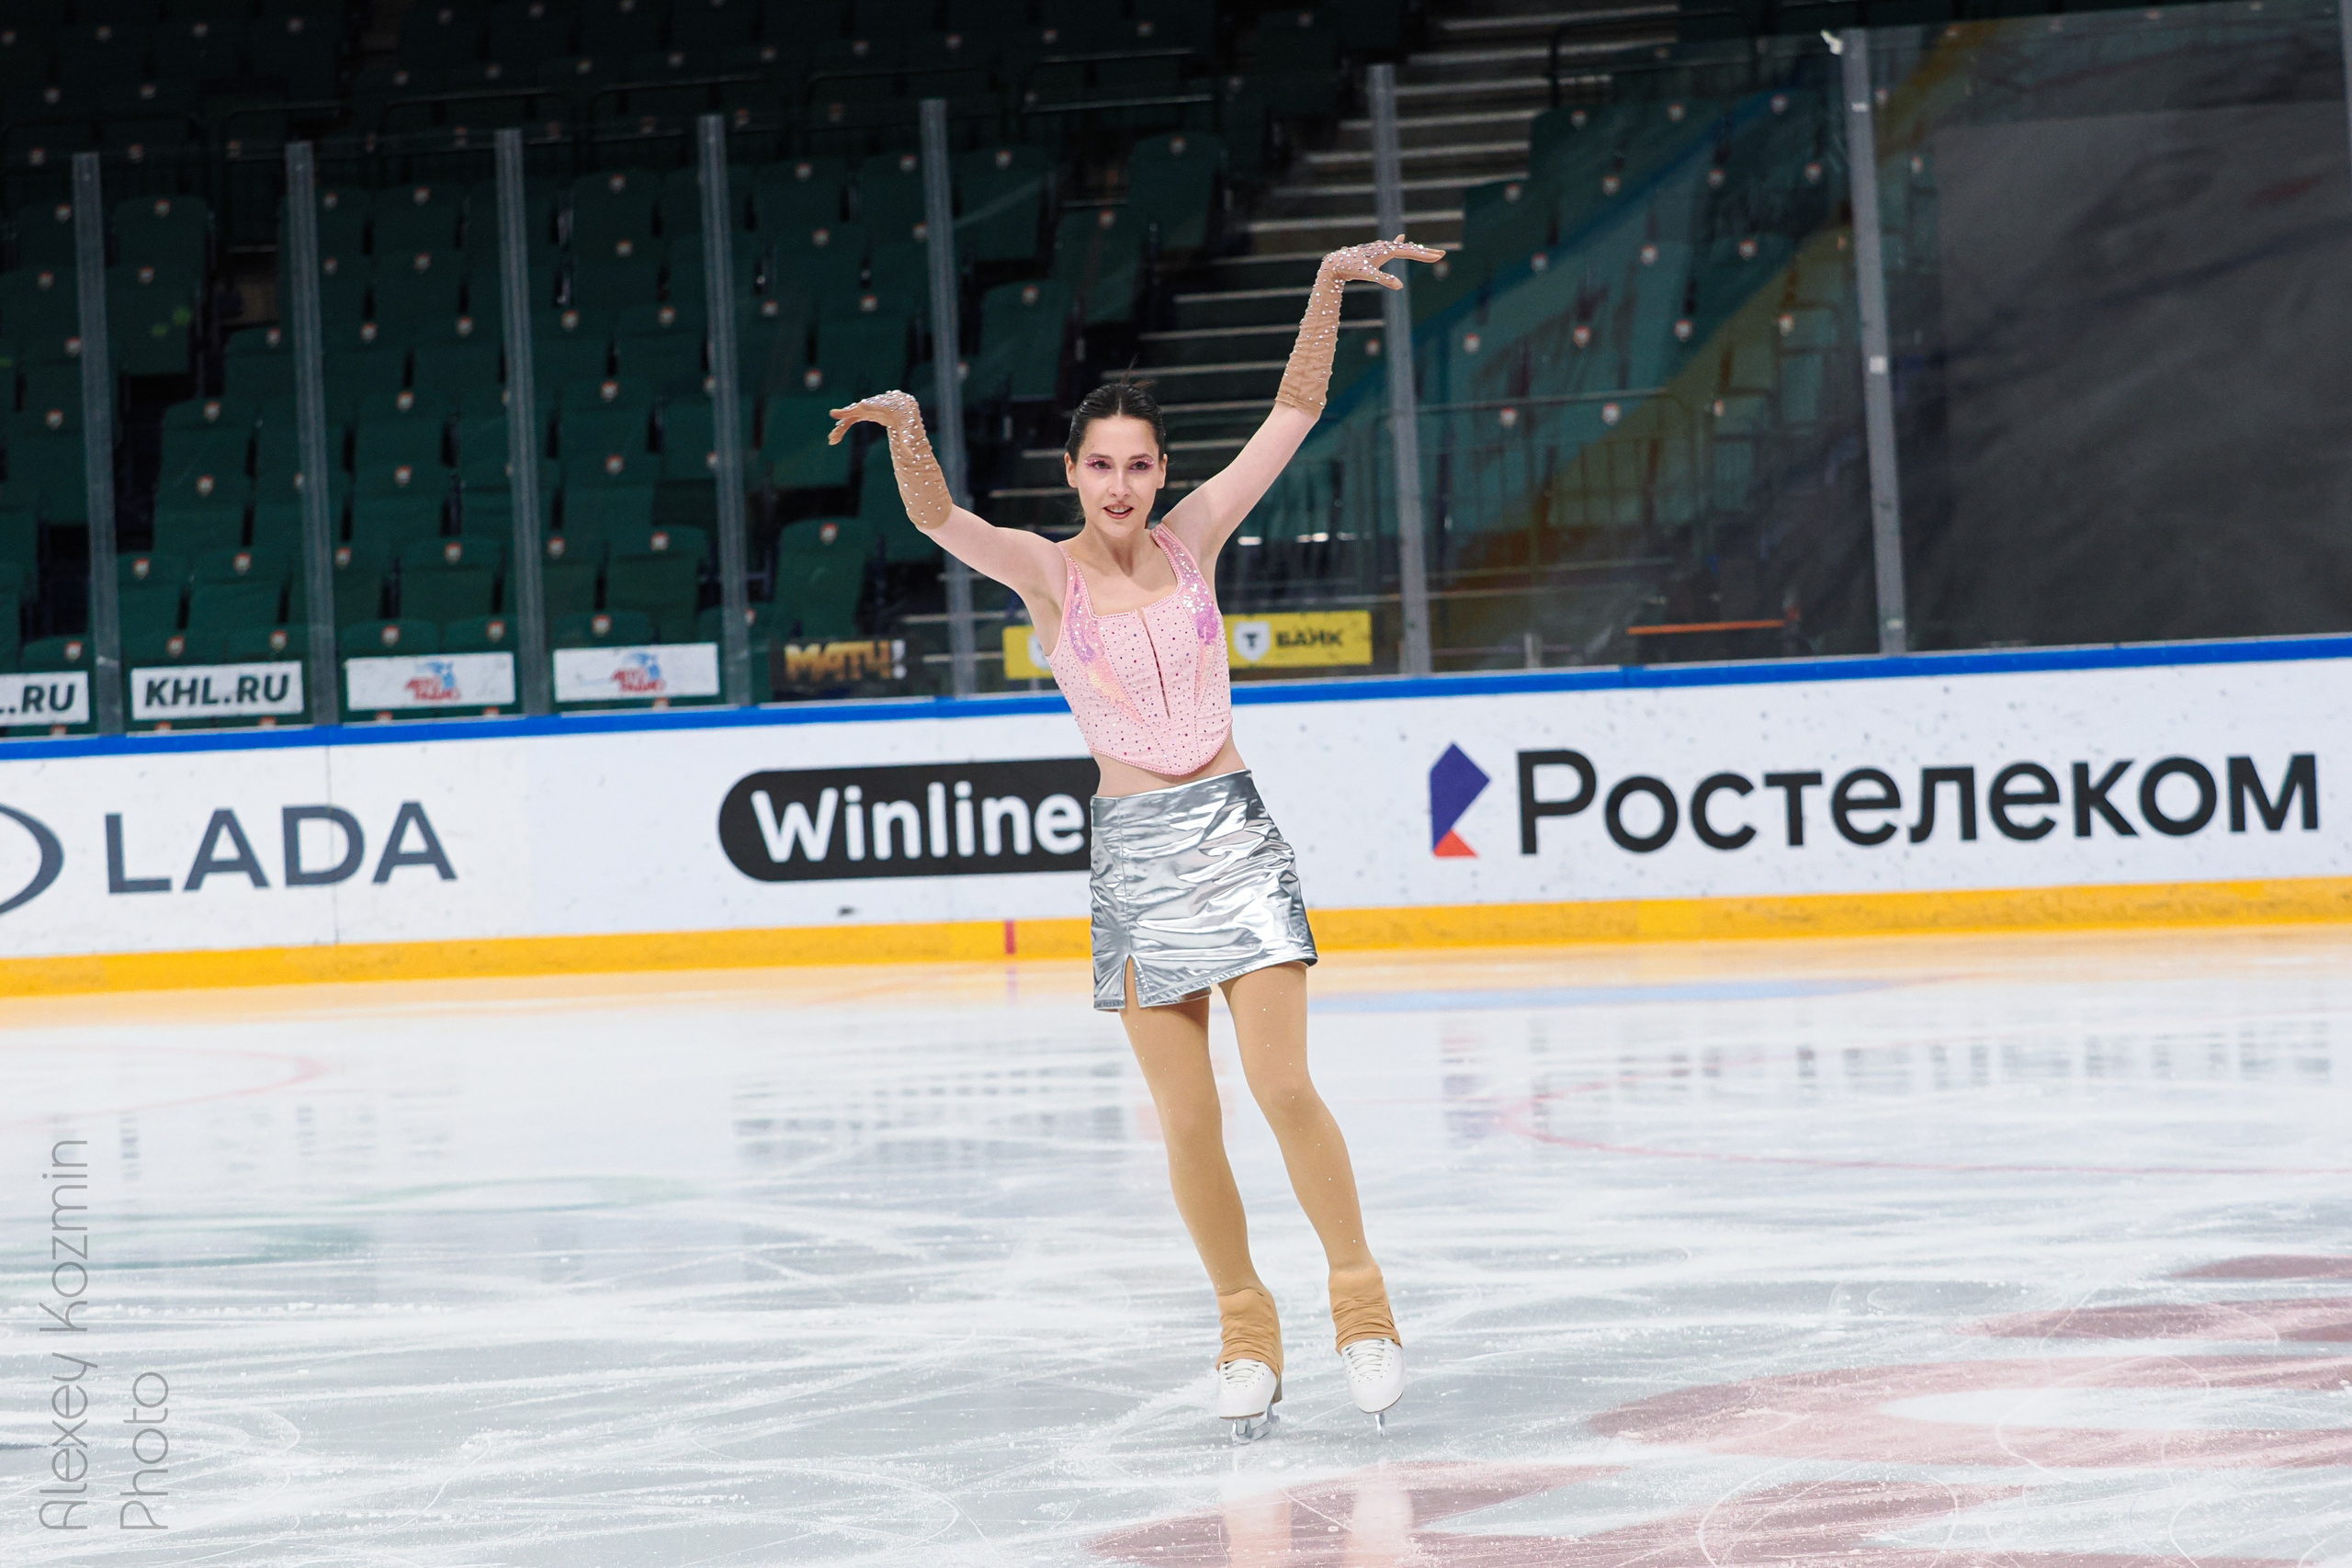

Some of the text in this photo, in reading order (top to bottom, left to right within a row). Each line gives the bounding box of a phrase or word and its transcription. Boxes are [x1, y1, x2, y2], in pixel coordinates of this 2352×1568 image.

[0, 684, 76, 715] .RU
[145, 673, 289, 707] KHL.RU
[751, 781, 1085, 863] Winline
[1515, 748, 2320, 855] Ростелеком
[105, 799, 458, 894] LADA
